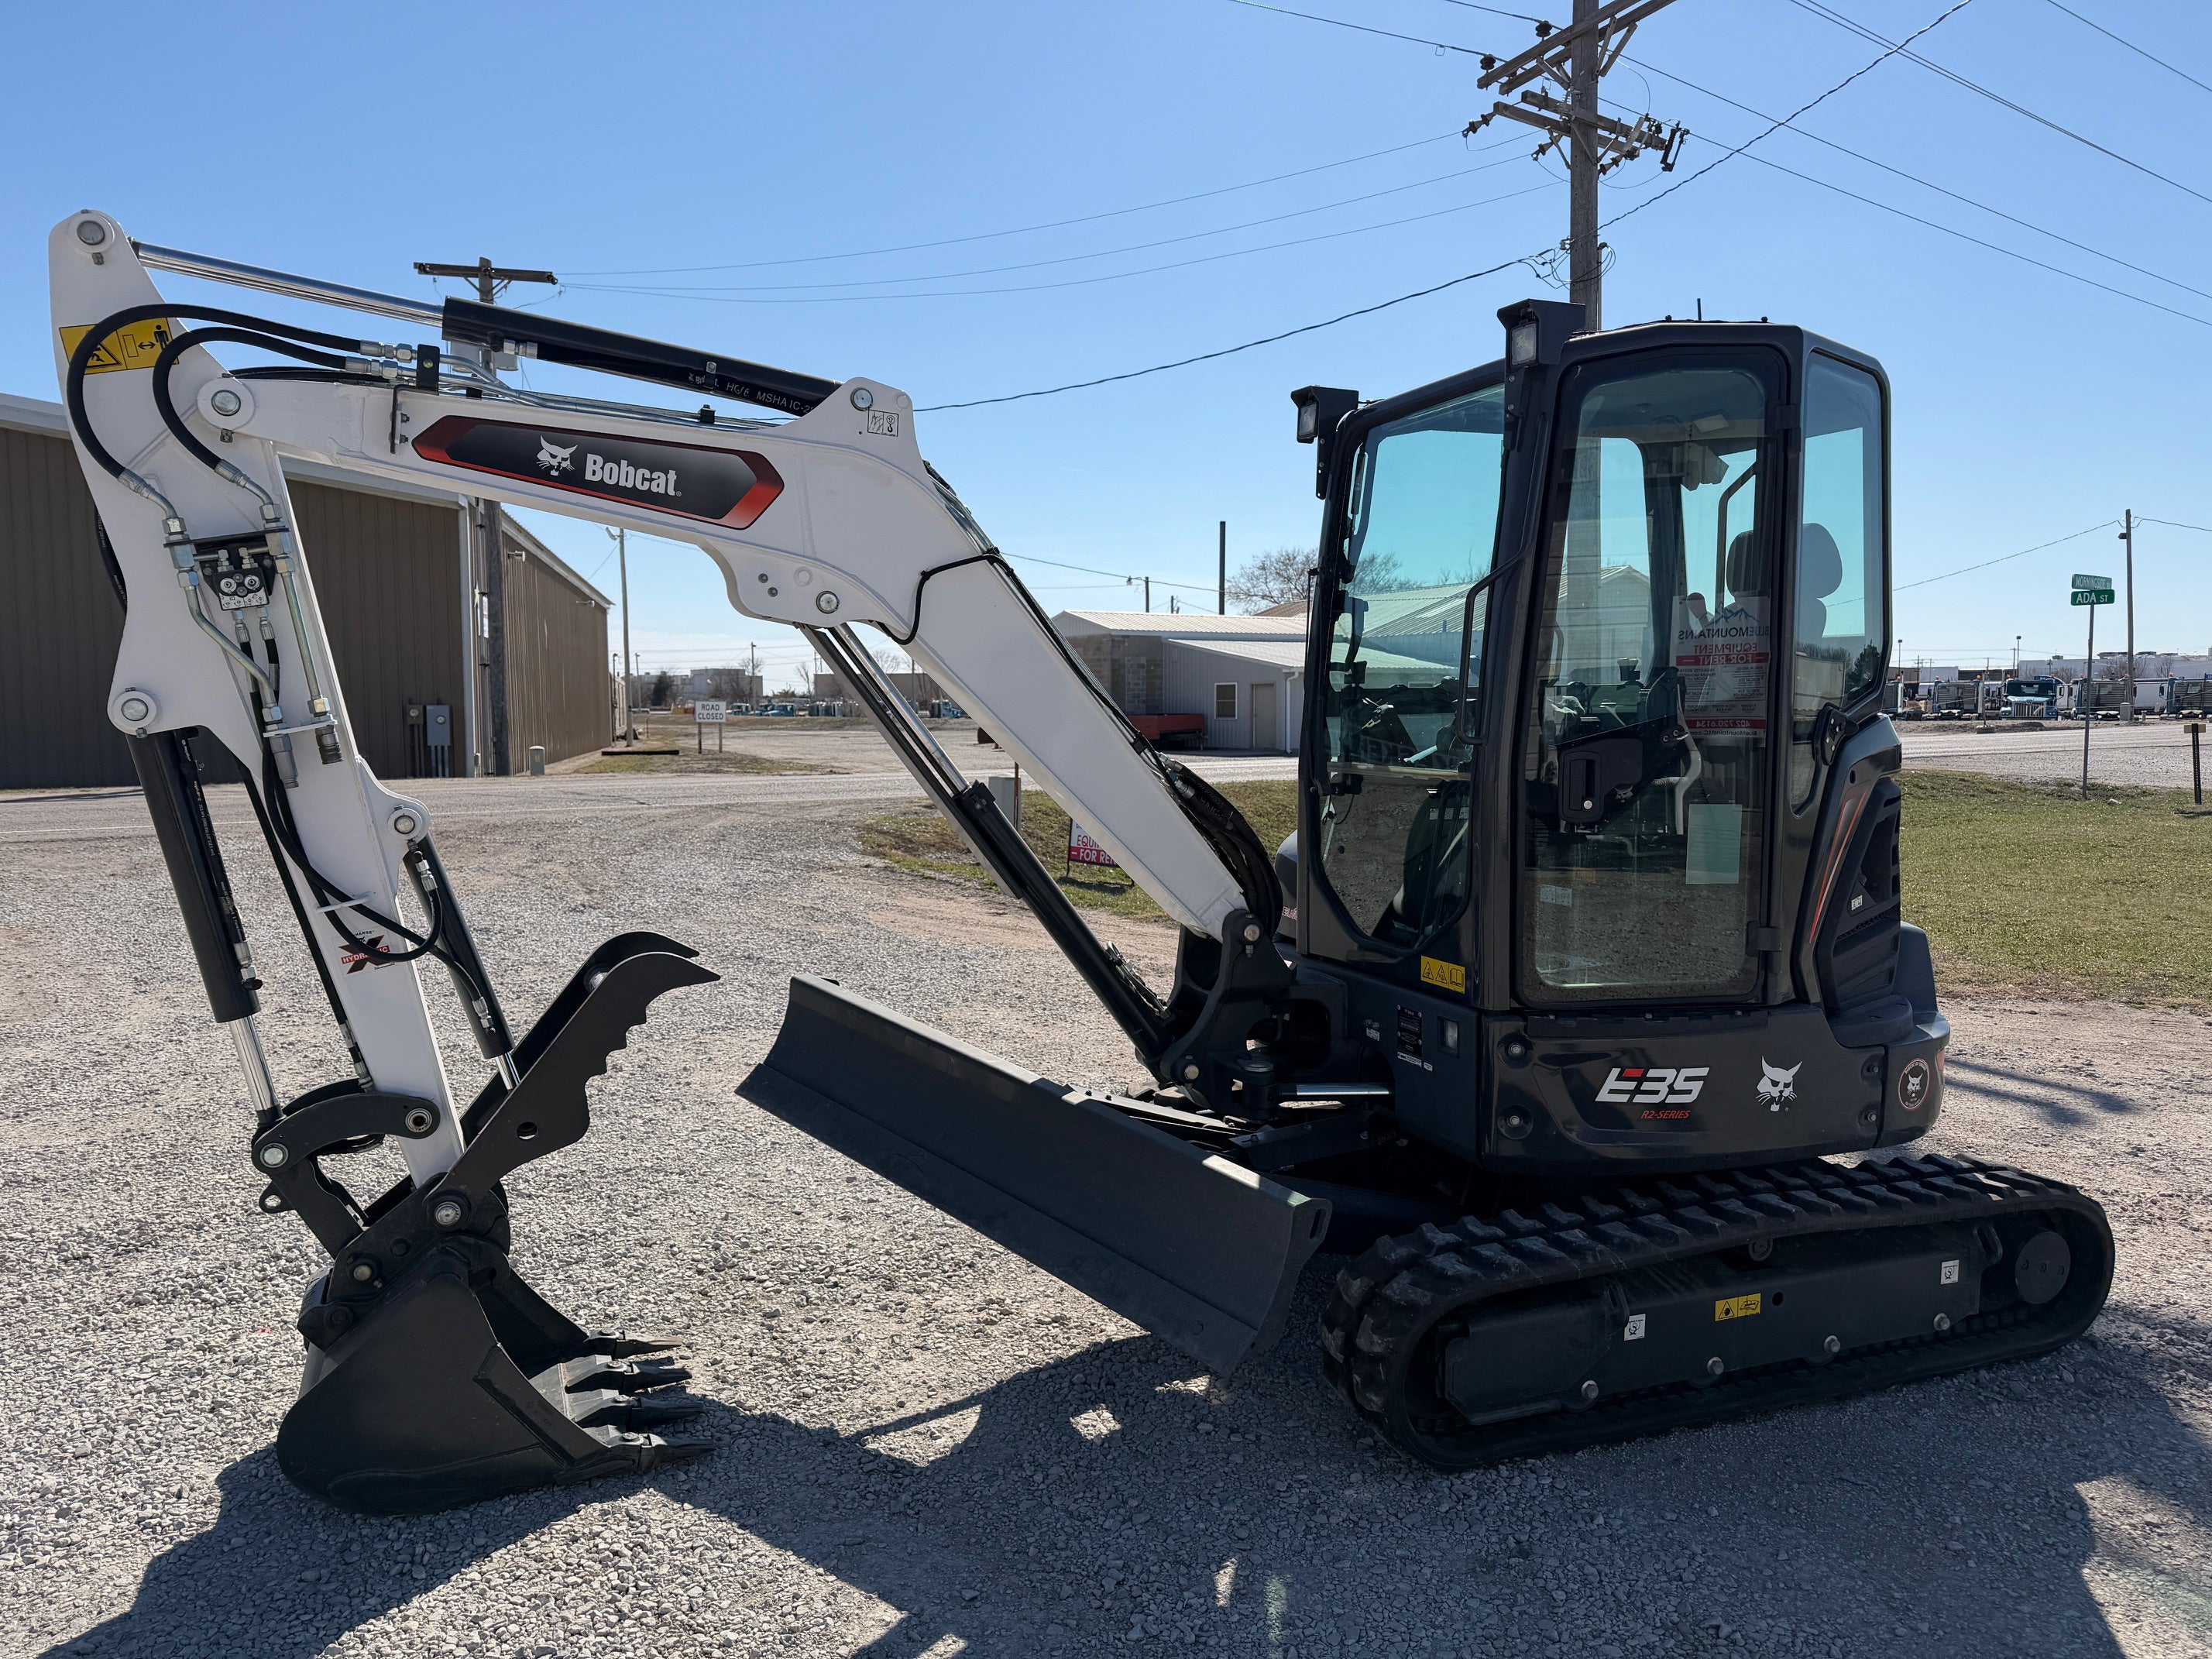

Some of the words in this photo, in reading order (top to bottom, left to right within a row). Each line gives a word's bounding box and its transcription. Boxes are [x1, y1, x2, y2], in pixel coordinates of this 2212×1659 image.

[756, 391, 787, 407] MSHA
[585, 453, 677, 496] Bobcat
[2076, 592, 2097, 604] ADA
[2100, 594, 2109, 603] ST
[1079, 848, 1097, 862] FOR
[1099, 851, 1116, 866] REN
[1594, 1067, 1710, 1104] E35
[1640, 1110, 1691, 1120] R2-SERIES
